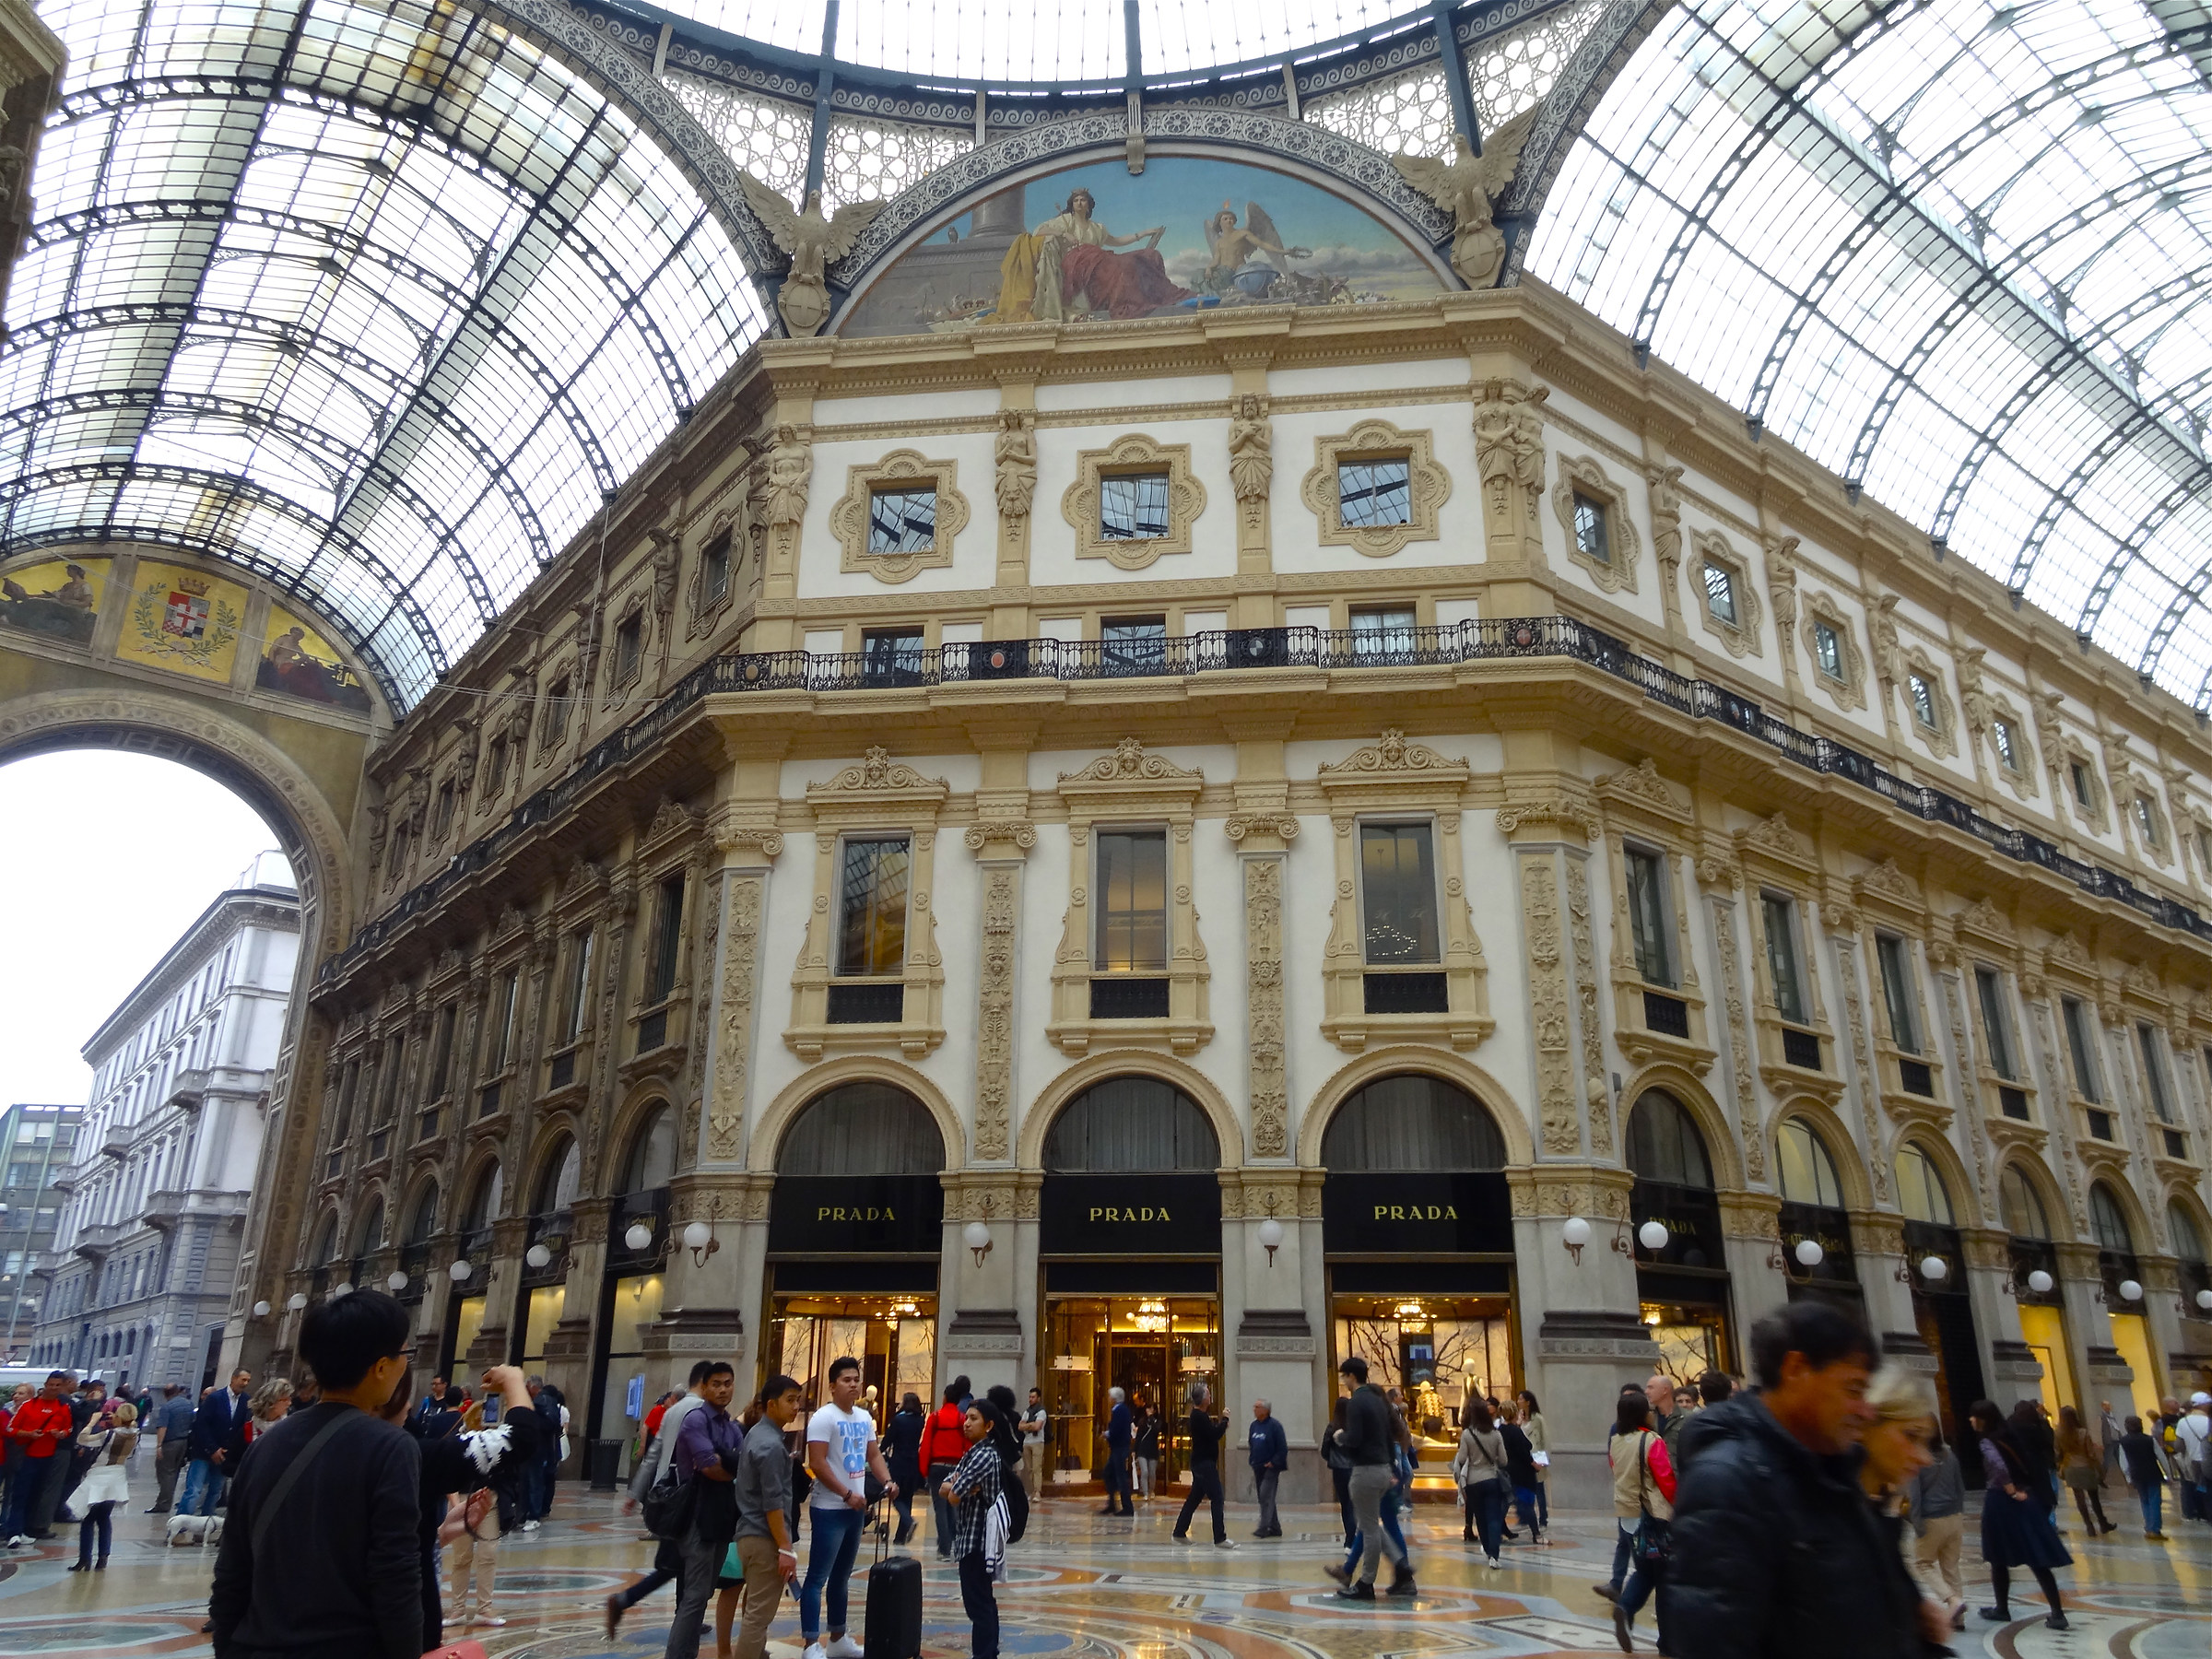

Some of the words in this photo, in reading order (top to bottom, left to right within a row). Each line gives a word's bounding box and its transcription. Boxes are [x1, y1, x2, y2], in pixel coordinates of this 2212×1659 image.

[818, 1206, 895, 1221] PRADA
[1089, 1207, 1171, 1221] PRADA
[1373, 1206, 1458, 1220] PRADA
[842, 1437, 863, 1453] ME
